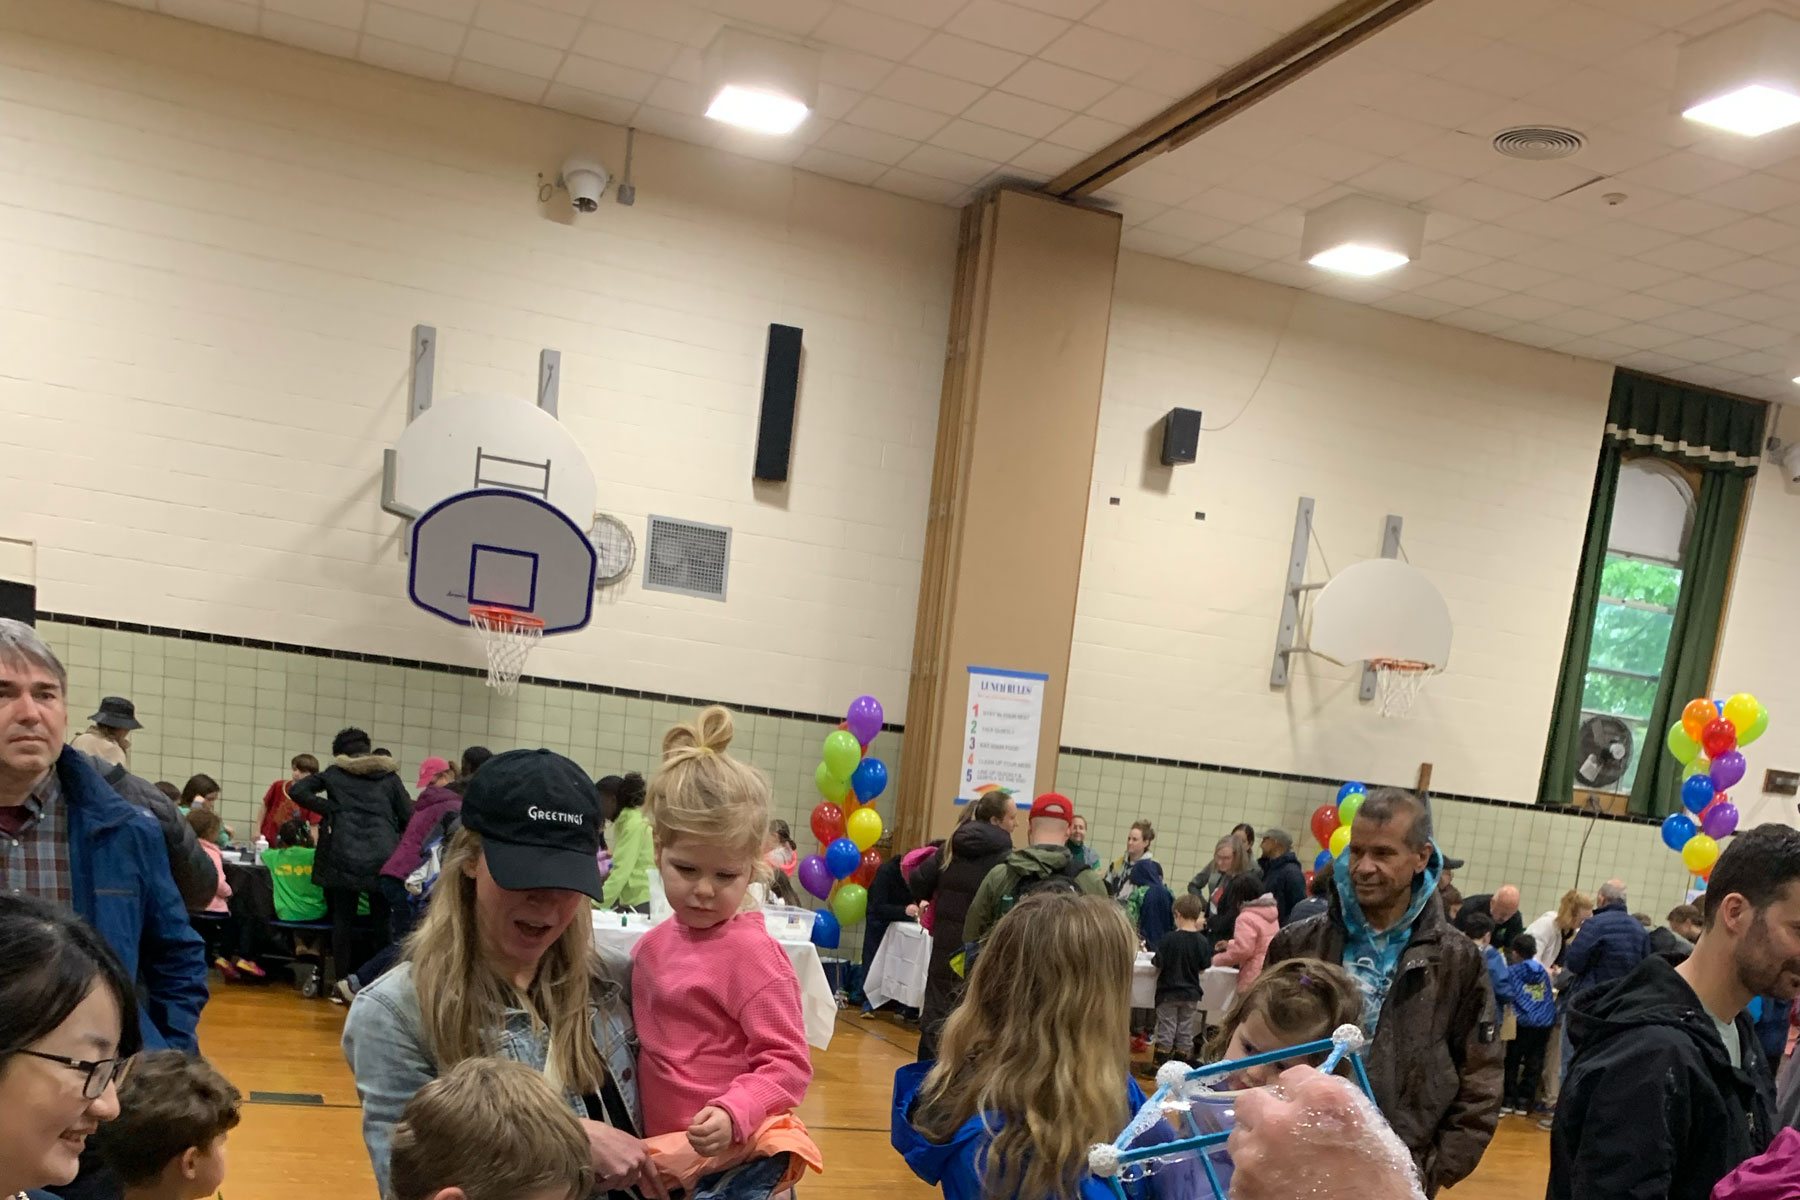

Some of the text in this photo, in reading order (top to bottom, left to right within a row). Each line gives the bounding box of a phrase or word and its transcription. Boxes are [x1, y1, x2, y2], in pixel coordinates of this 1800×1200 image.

[981, 681, 1032, 695] LUNCH RULES
[972, 703, 979, 717] 1
[971, 720, 977, 734] 2
[969, 737, 976, 750] 3
[968, 752, 974, 766] 4
[966, 768, 973, 782] 5
[528, 805, 583, 826] GREETINGS
